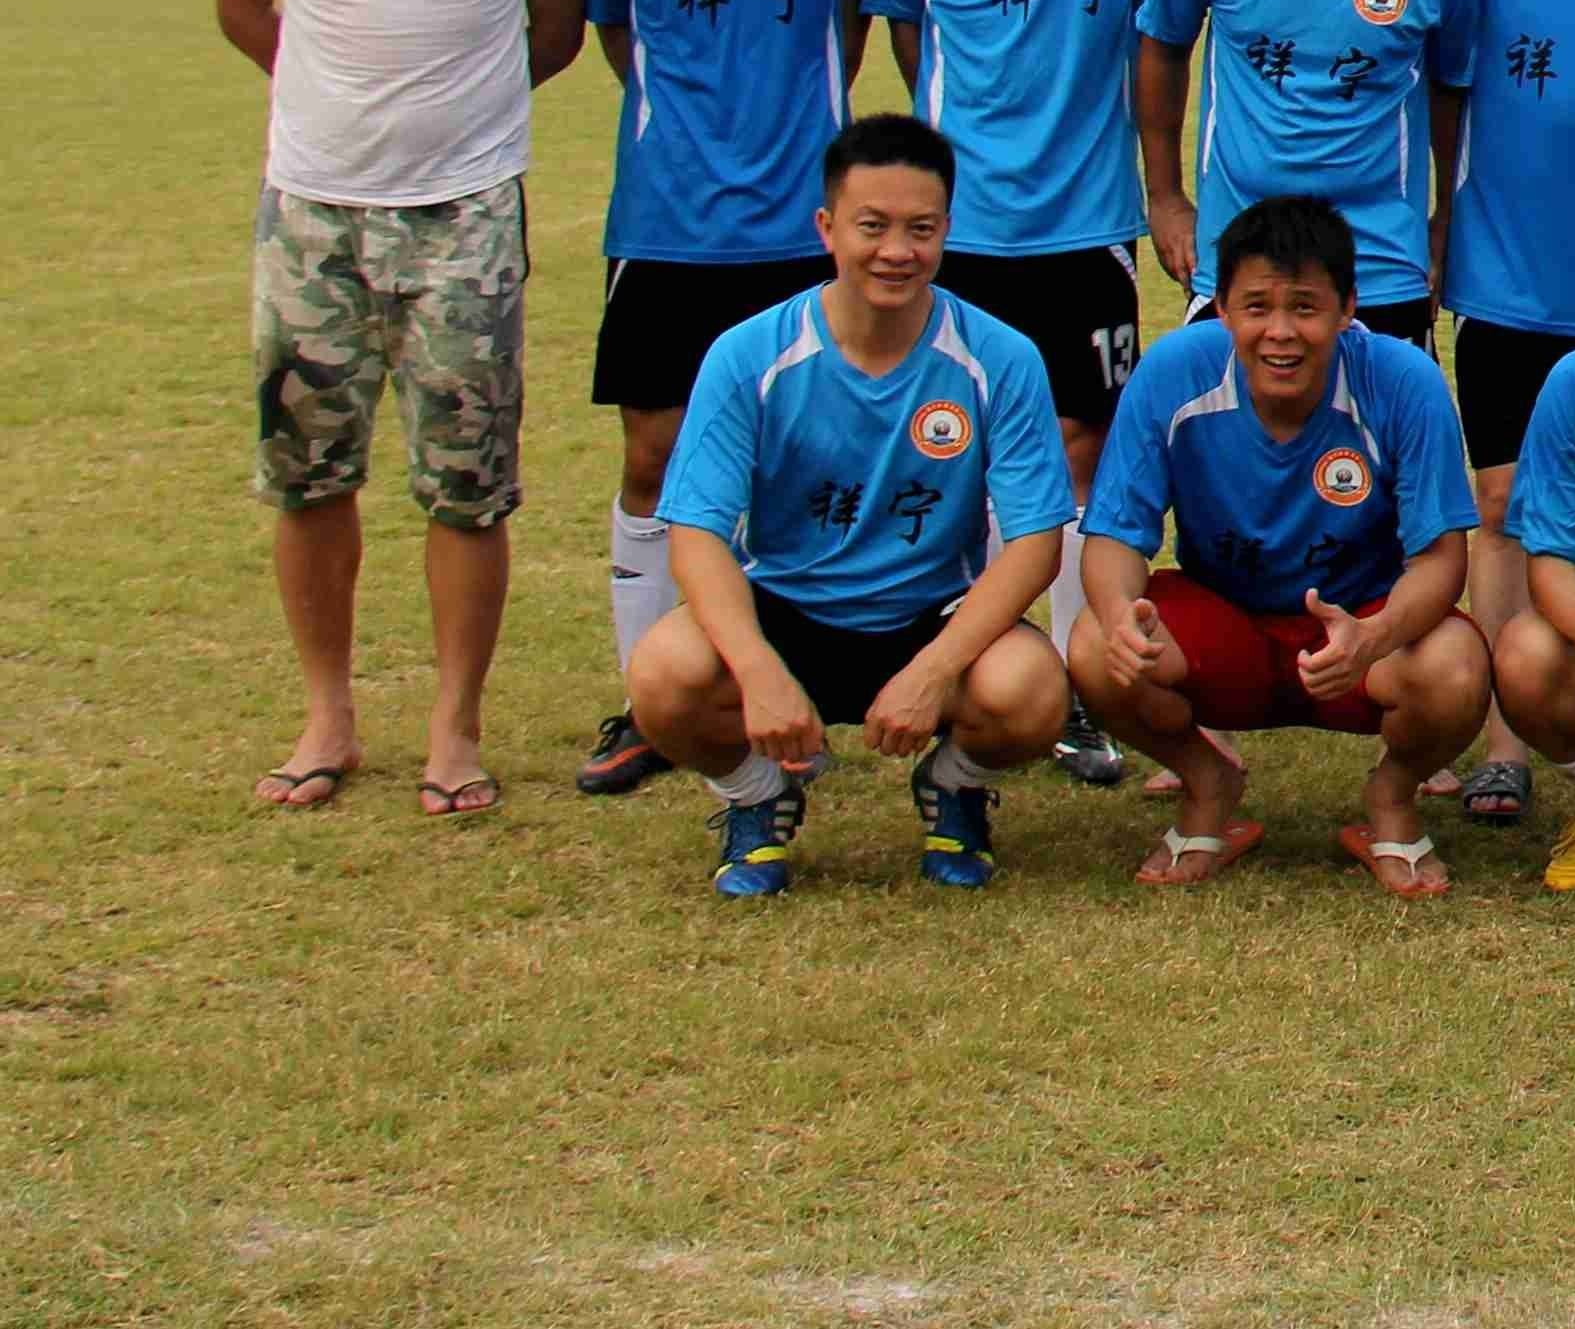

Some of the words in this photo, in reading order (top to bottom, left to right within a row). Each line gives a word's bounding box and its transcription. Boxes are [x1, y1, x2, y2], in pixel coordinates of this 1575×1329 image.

[1246, 32, 1377, 100] 祥宁
[1091, 322, 1137, 390] 13
[808, 480, 941, 545] 祥宁
